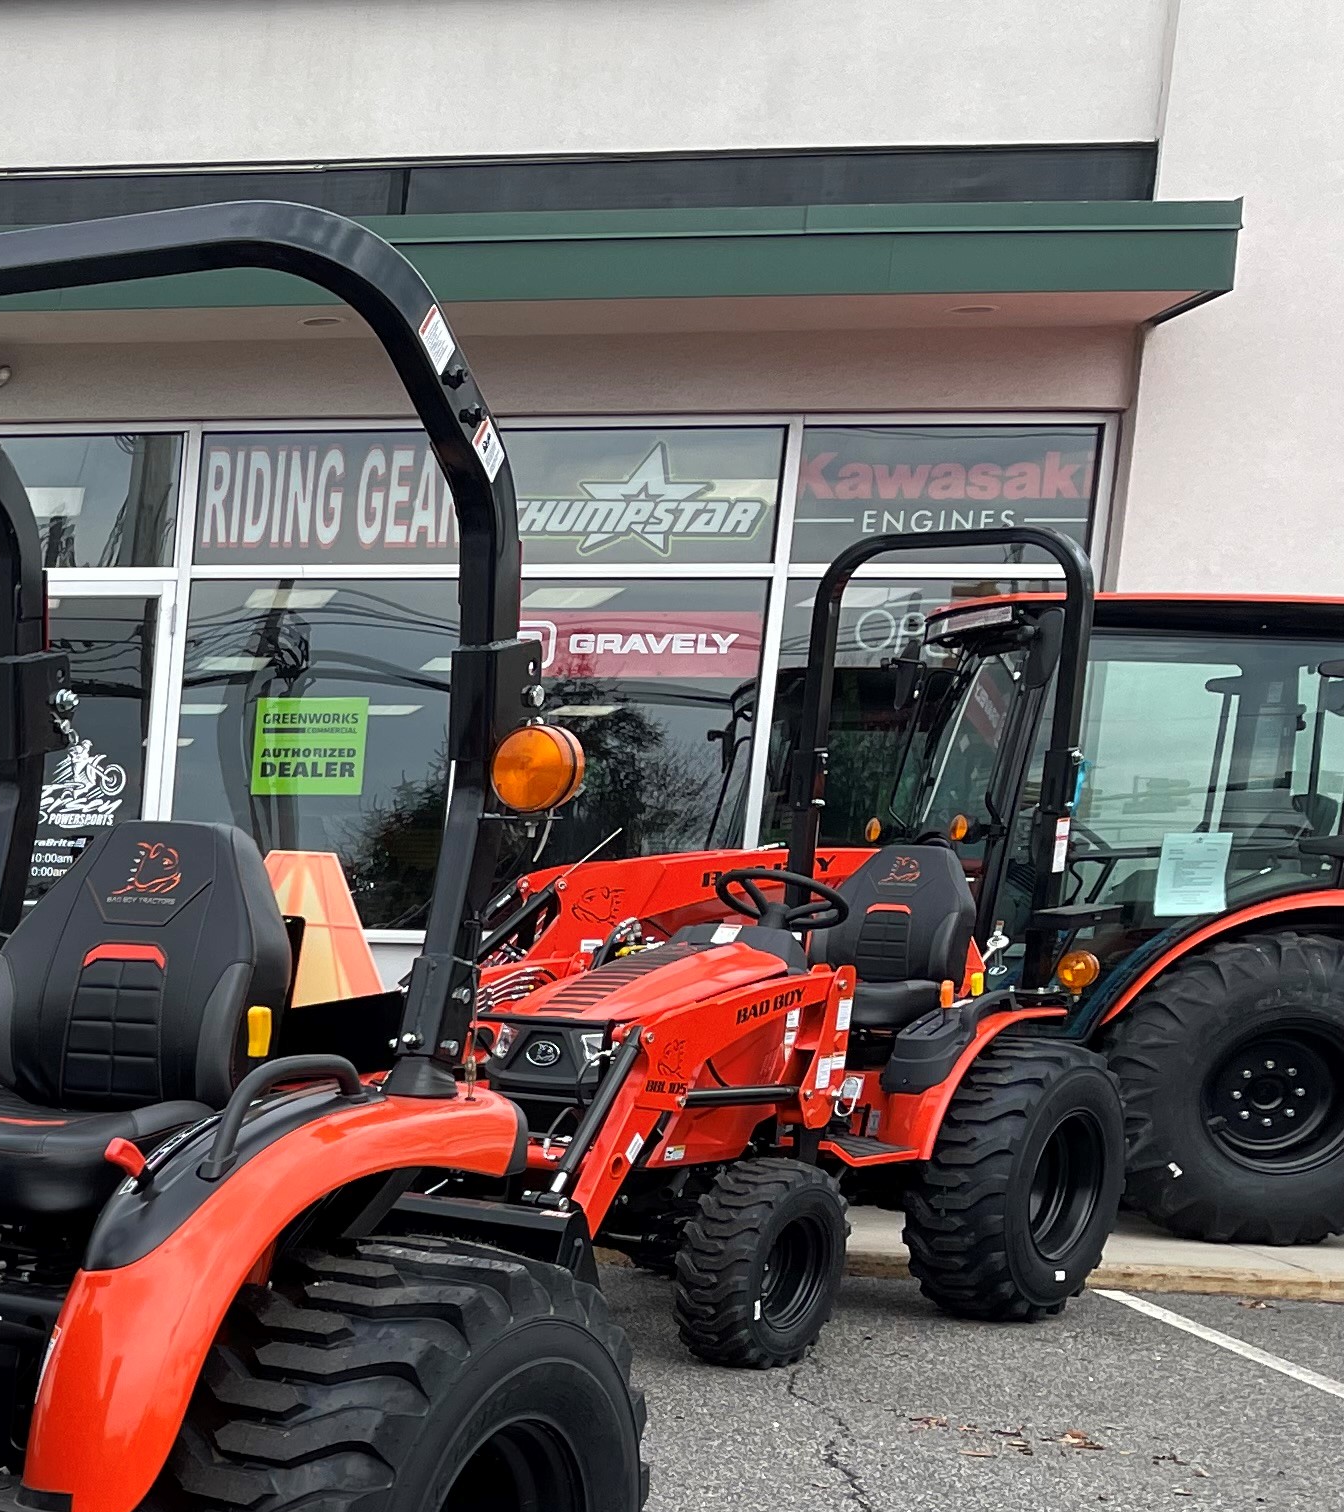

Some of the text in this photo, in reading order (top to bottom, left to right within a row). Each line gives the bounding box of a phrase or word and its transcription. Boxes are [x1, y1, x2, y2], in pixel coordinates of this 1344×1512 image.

[797, 452, 1094, 500] Kawasaki
[202, 445, 344, 548] RIDING
[862, 510, 1015, 532] ENGINES
[568, 632, 740, 655] GRAVELY
[263, 713, 359, 724] GREENWORKS
[261, 748, 357, 758] AUTHORIZED
[260, 762, 355, 778] DEALER
[48, 813, 115, 827] POWERSPORTS
[736, 1001, 770, 1026] BAD
[773, 986, 806, 1010] BOY
[645, 1079, 688, 1095] BBL 105
